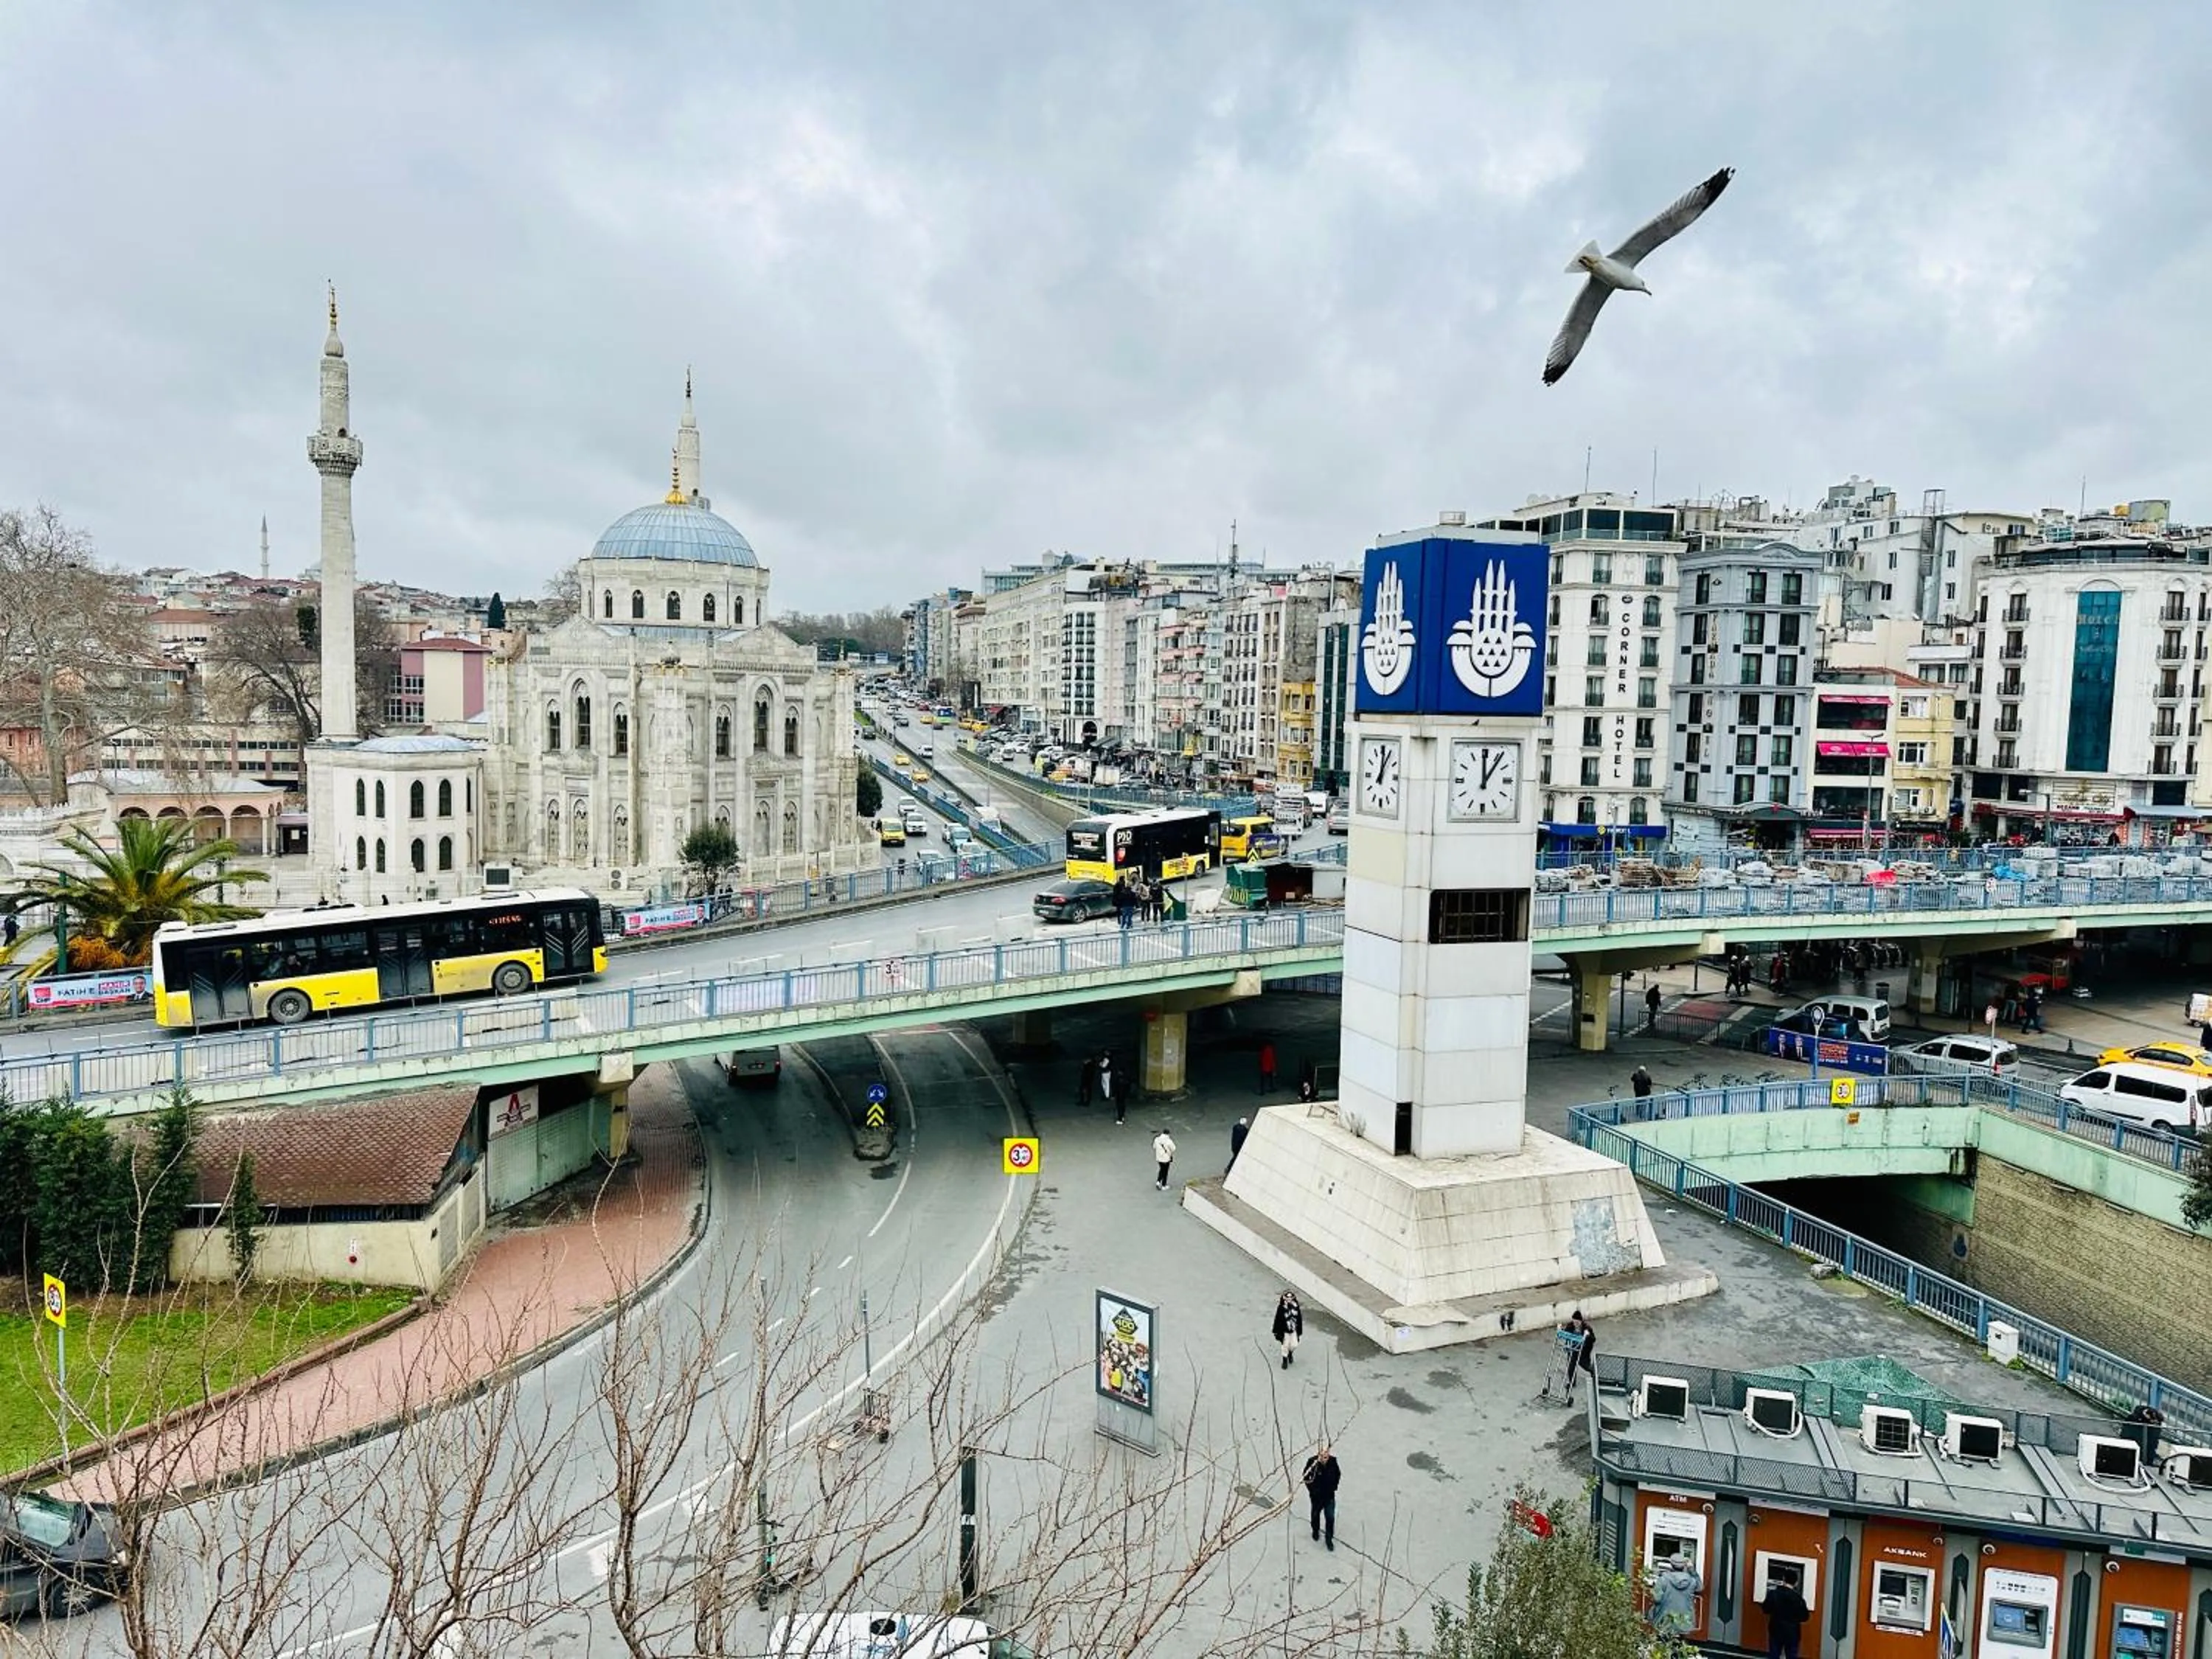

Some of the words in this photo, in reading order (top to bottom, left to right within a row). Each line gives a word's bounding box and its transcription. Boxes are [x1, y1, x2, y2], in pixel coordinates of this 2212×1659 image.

[1618, 613, 1630, 692] CORNER
[1614, 714, 1624, 778] HOTEL
[1669, 1495, 1687, 1503] ATM
[1883, 1546, 1927, 1558] AKBANK
